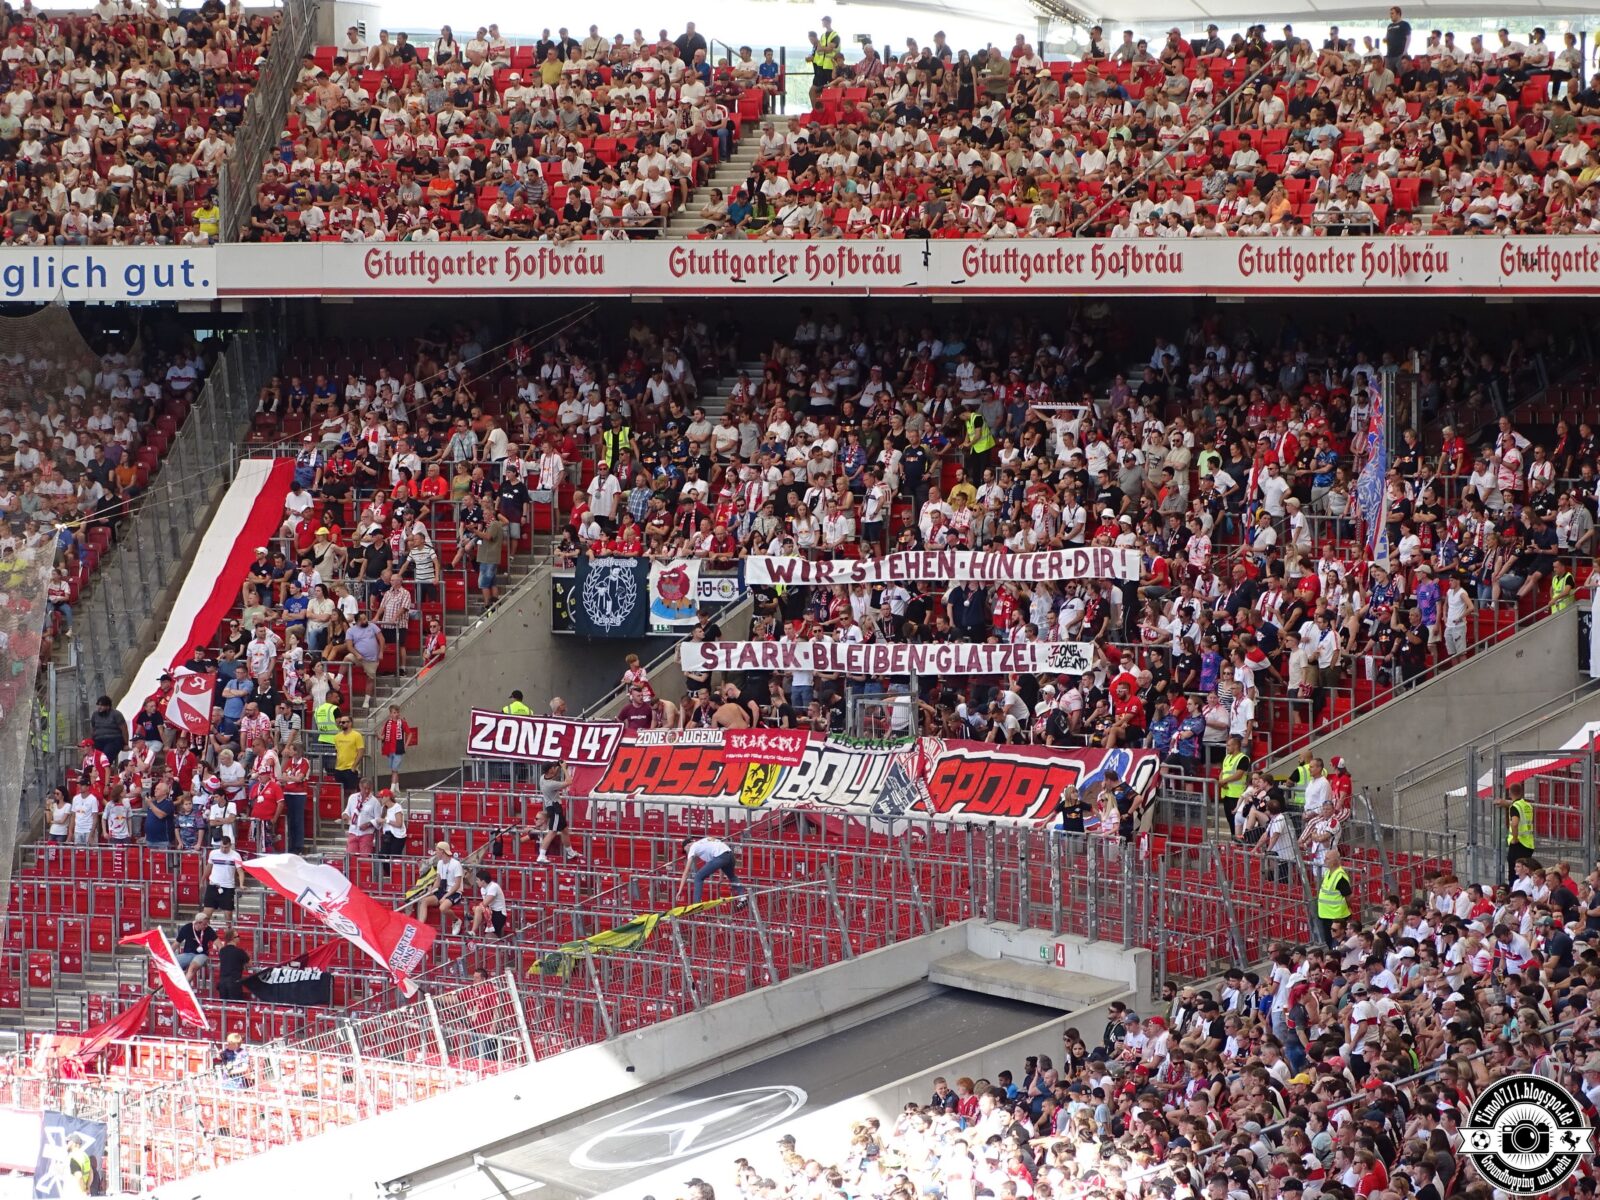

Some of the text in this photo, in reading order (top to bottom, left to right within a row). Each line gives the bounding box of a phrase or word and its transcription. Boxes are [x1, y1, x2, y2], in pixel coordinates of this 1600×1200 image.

[2, 255, 210, 297] glich gut.
[364, 247, 607, 285] Stuttgarter Hofbräu
[669, 245, 904, 282] Stuttgarter Hofbräu
[963, 244, 1183, 283] Stuttgarter Hofbräu
[1238, 242, 1449, 282] Stuttgarter Hofbräu
[764, 546, 1127, 583] WIR STEHEN HINTER DIR!
[700, 642, 1037, 674] STARK BLEIBEN GLATZE!
[1047, 655, 1089, 671] JUGEND
[1051, 644, 1080, 657] ZONE
[470, 714, 619, 761] ZONE 147
[637, 731, 665, 744] ZONE
[678, 730, 723, 744] JUGEND
[596, 745, 750, 798] RASEN
[913, 755, 1080, 819] SPORT
[388, 926, 416, 969] RFURTER
[1057, 945, 1064, 965] 4
